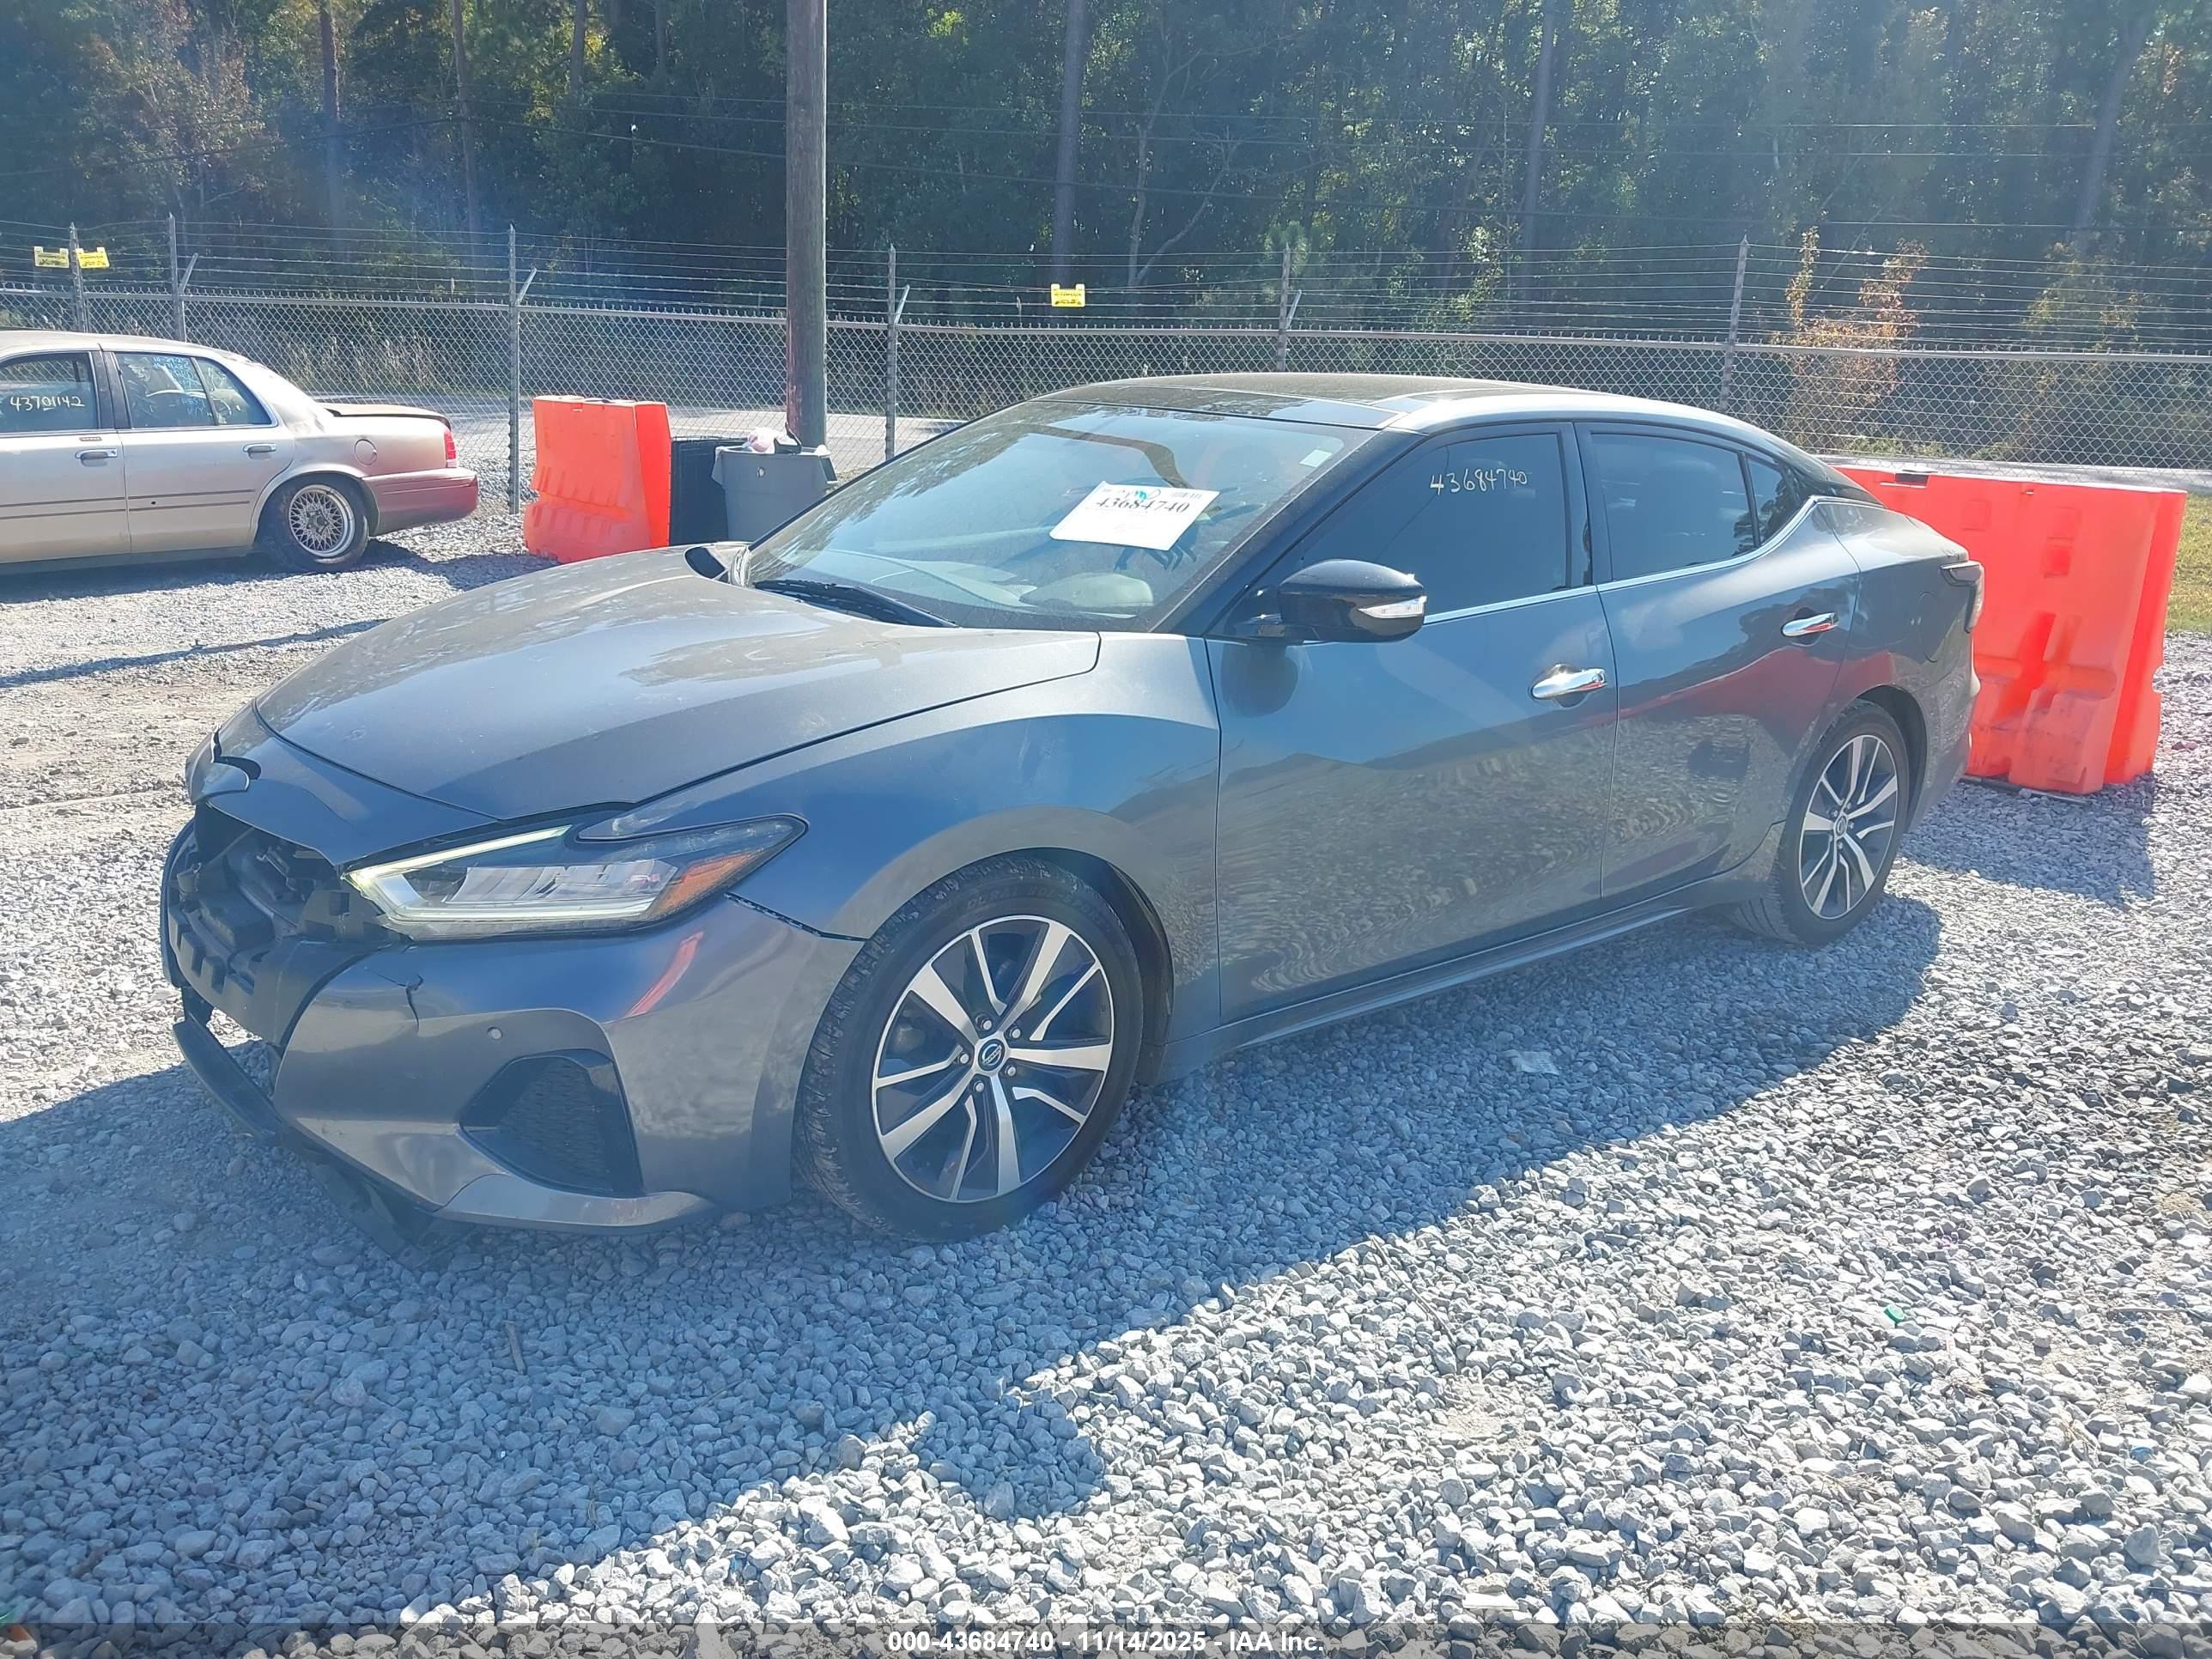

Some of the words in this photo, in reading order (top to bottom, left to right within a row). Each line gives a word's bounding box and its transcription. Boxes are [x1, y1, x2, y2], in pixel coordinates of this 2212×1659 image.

[10, 396, 85, 411] 43701142
[1430, 468, 1528, 495] 43684740
[1097, 497, 1190, 513] 43684740
